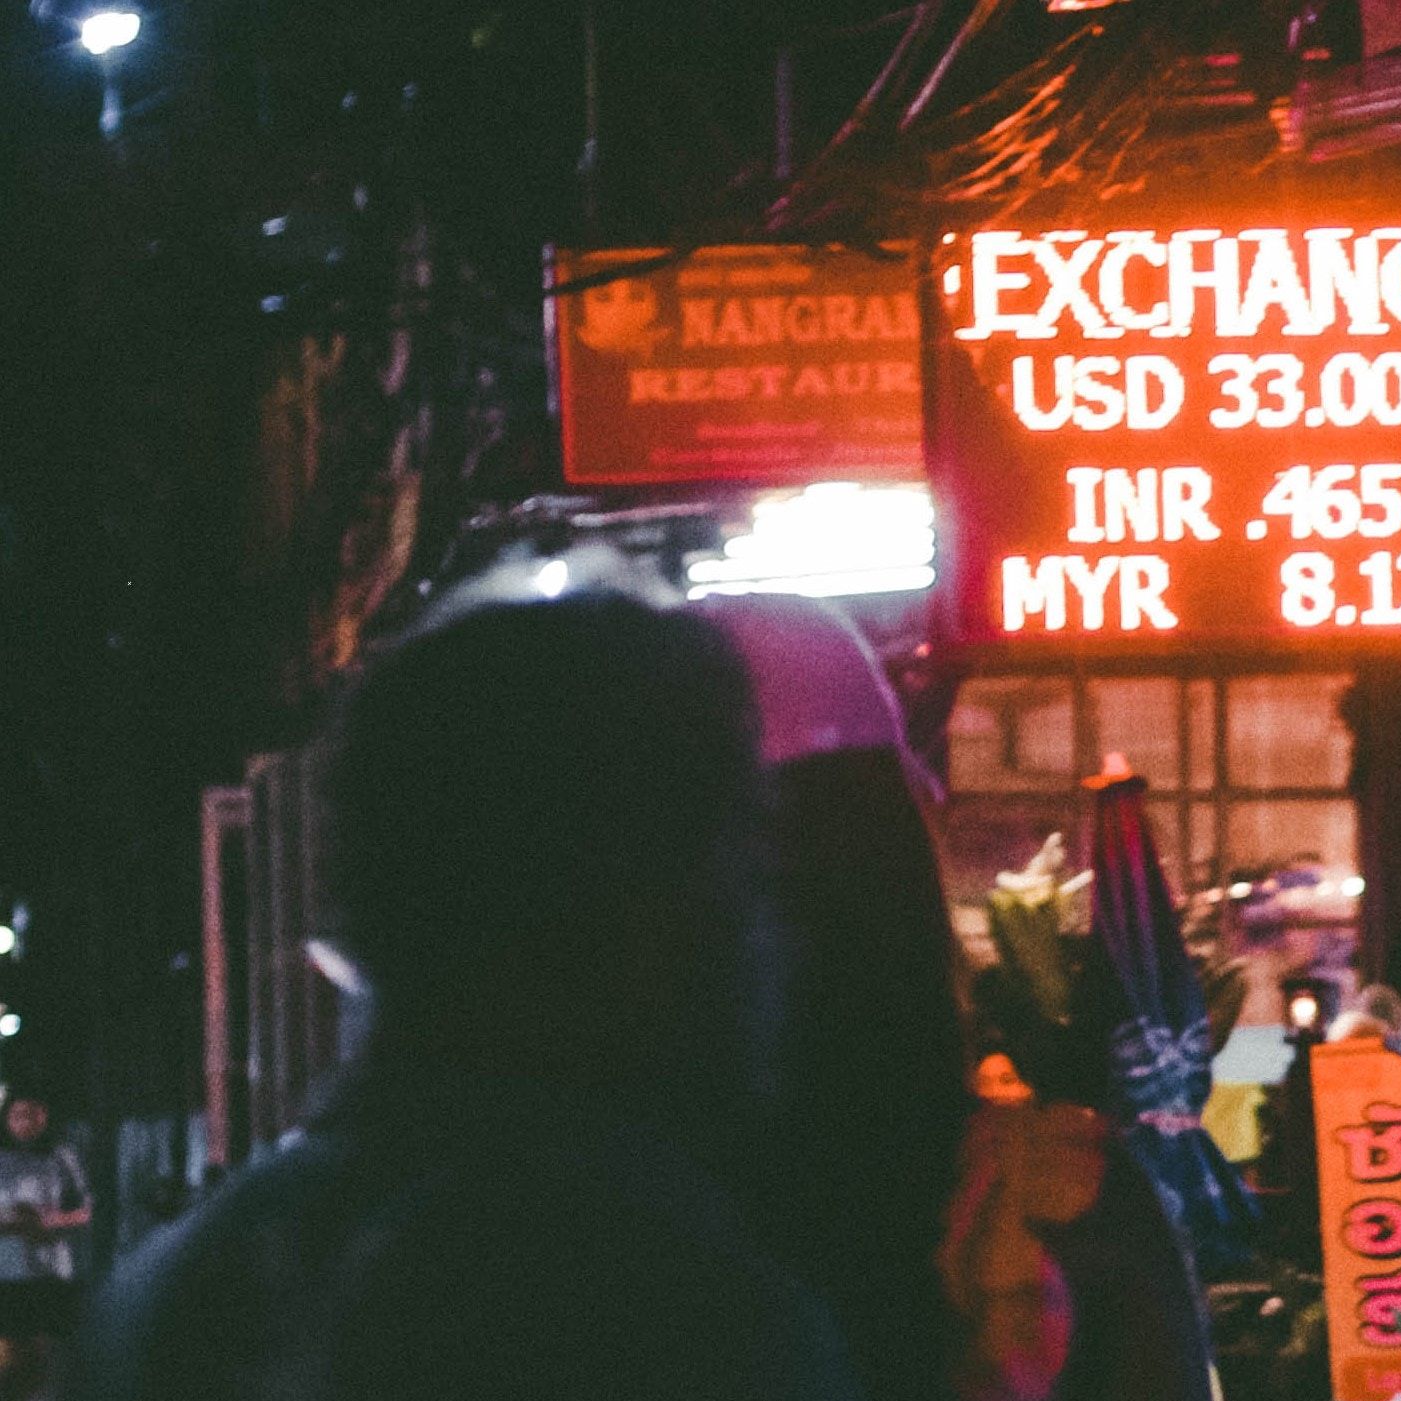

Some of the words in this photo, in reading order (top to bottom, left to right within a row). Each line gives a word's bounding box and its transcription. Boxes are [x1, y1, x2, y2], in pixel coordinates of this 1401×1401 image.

[1012, 354, 1185, 430] USD
[1066, 466, 1221, 543] INR
[1002, 554, 1178, 632] MYR
